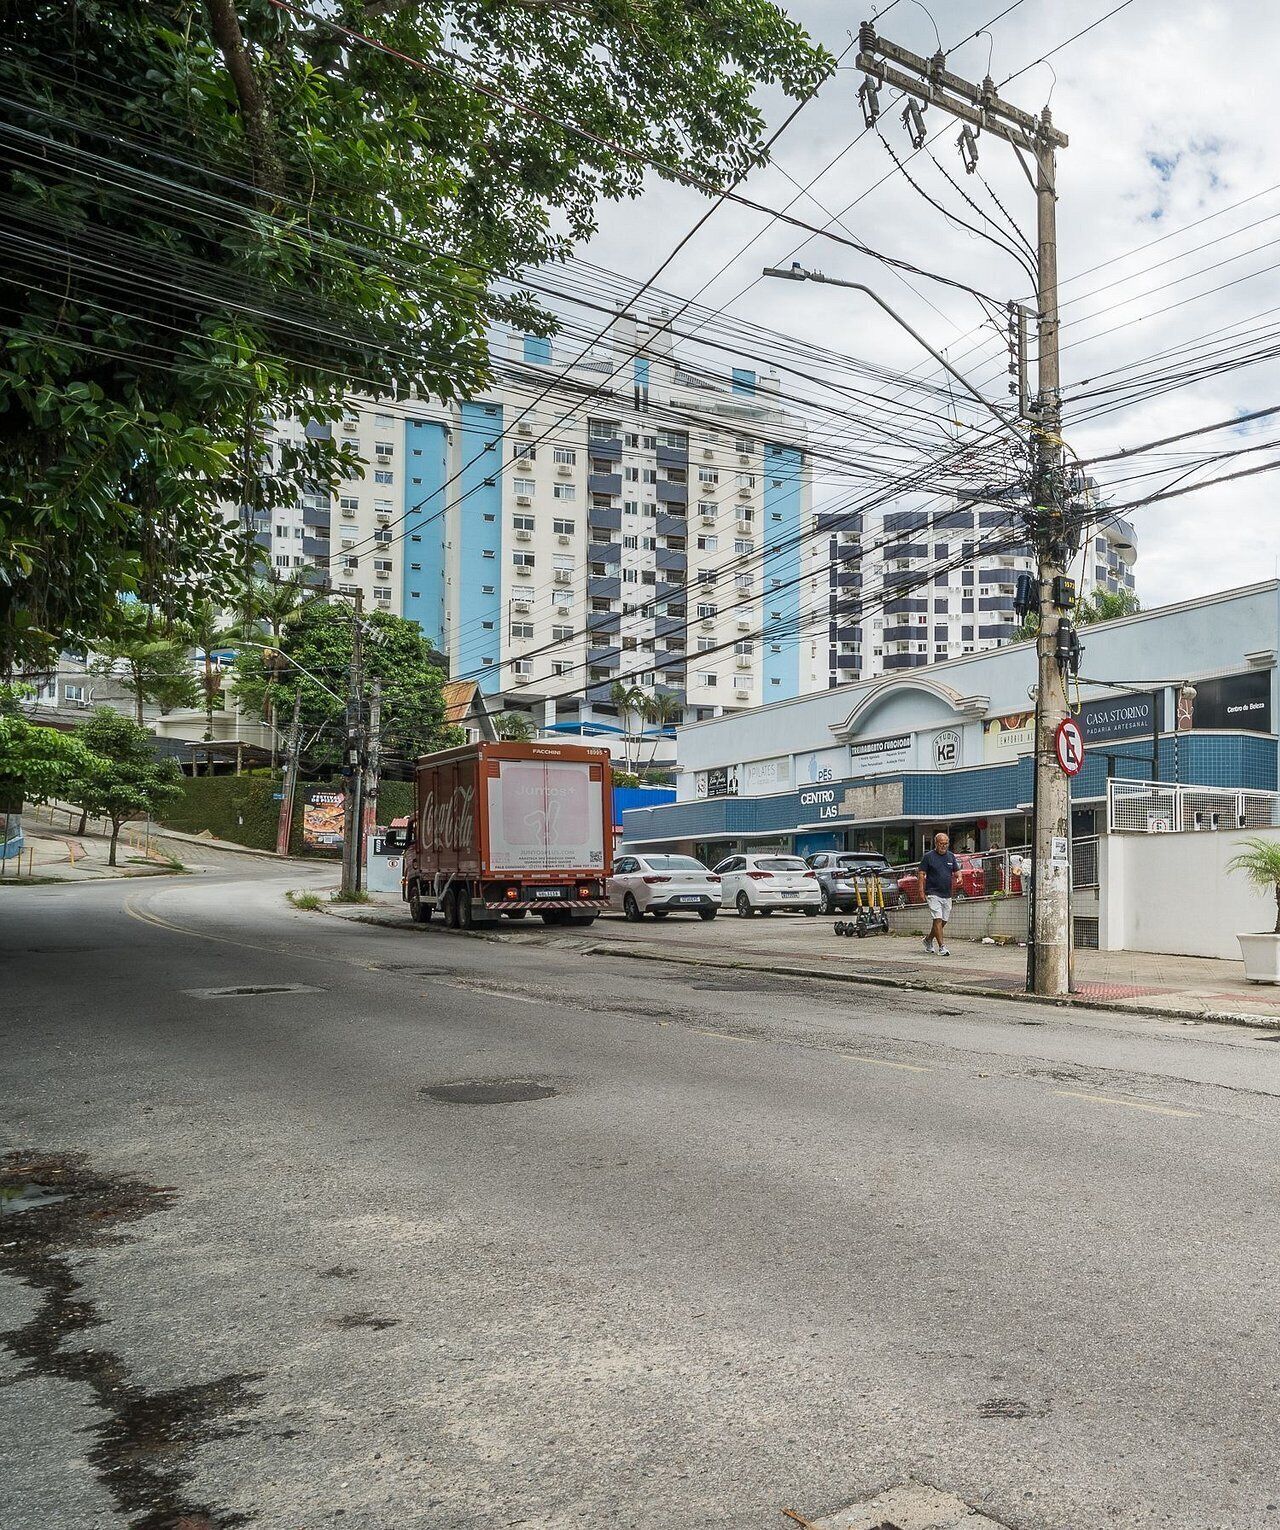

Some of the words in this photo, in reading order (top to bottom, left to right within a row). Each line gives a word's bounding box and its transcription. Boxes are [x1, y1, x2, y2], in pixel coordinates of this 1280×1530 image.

[1086, 713, 1109, 725] CASA
[1110, 704, 1149, 722] STORINO
[1227, 706, 1242, 714] Centro
[1249, 702, 1265, 710] Beleza
[1086, 727, 1111, 735] PADARIA
[1113, 721, 1148, 731] ARTESANAL
[937, 743, 955, 762] K2
[801, 790, 835, 805] CENTRO
[820, 805, 838, 819] LAS
